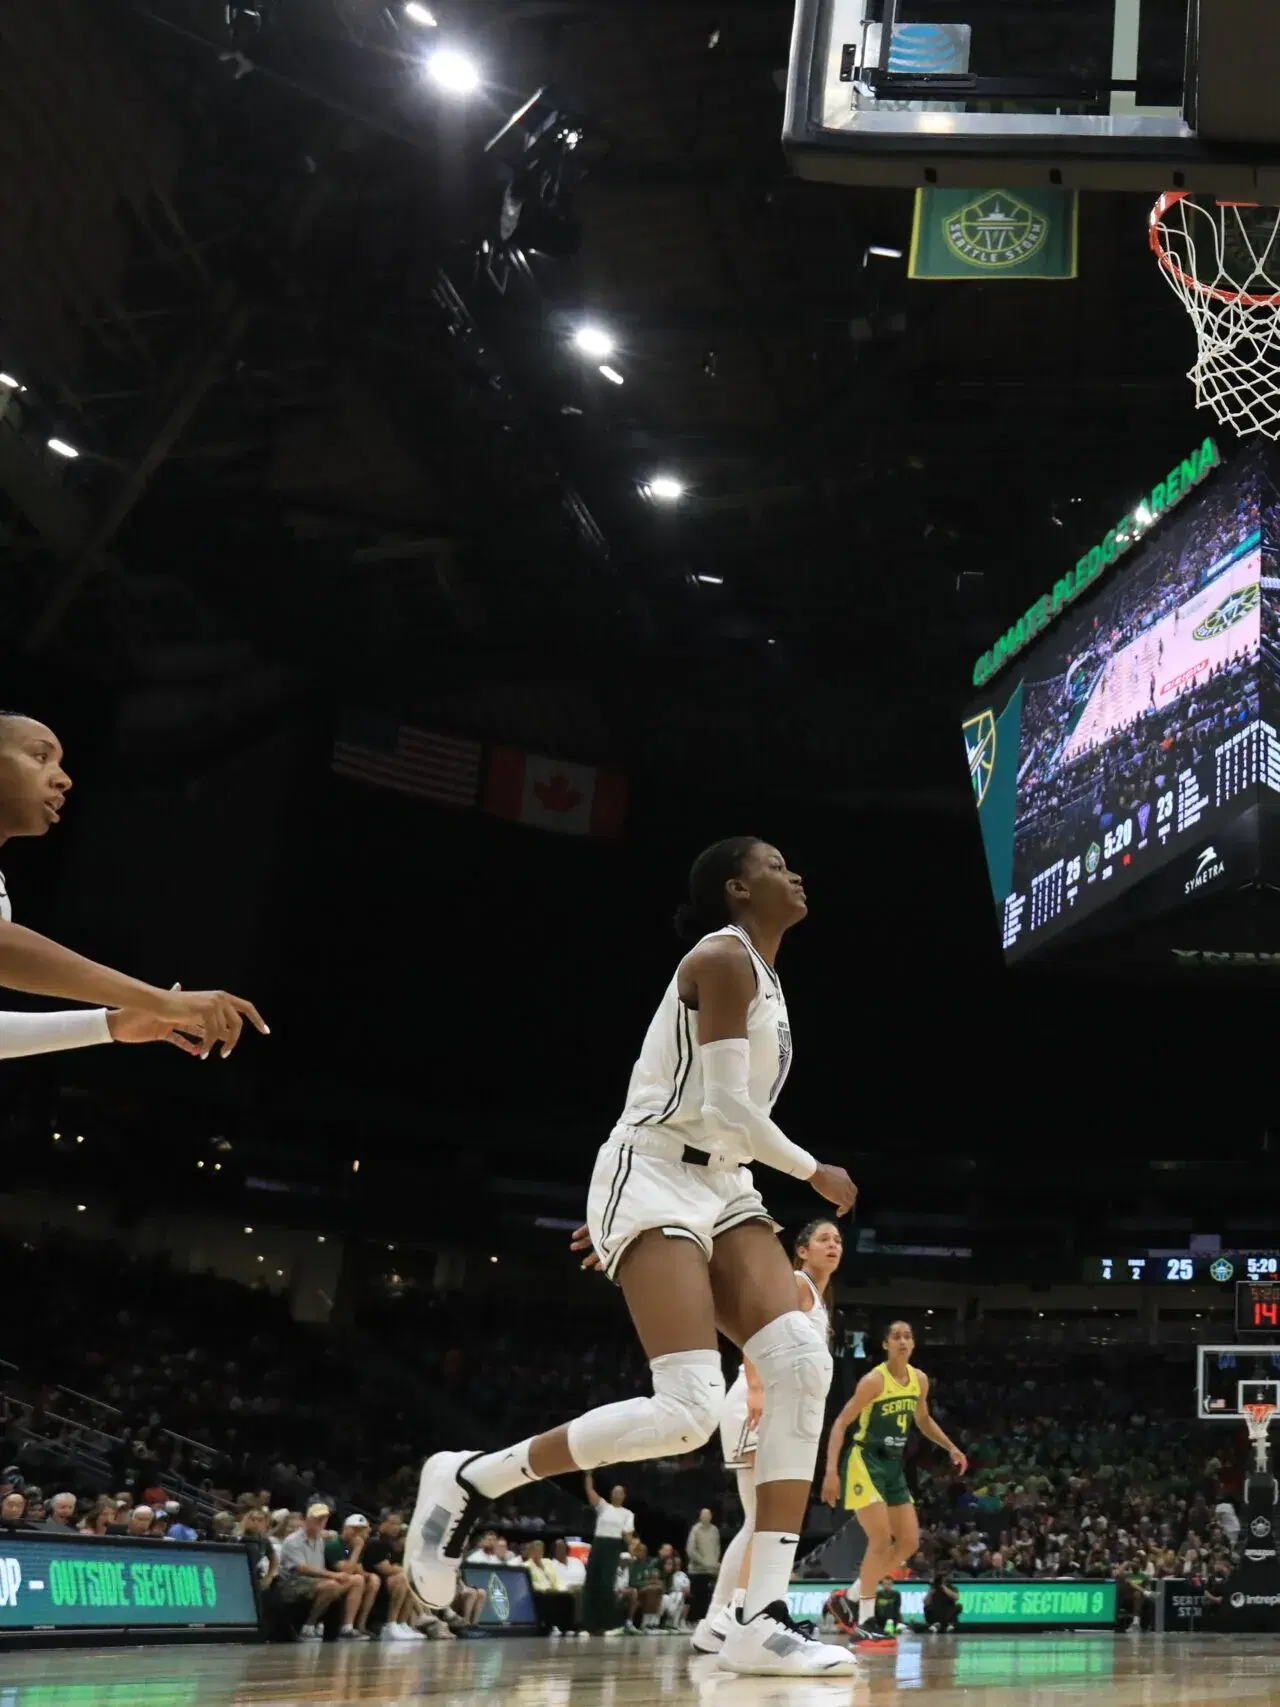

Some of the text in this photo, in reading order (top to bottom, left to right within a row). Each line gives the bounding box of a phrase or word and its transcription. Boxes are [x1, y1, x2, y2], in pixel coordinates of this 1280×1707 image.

[950, 223, 1042, 262] SEATTLE STORM
[973, 594, 1051, 686] CLIMATE
[1136, 436, 1217, 530] ARENA
[1156, 790, 1174, 823] 23
[1103, 818, 1133, 860] 5:20
[1066, 855, 1081, 886] 25
[1184, 860, 1225, 895] SYMETRA
[1131, 1267, 1141, 1280] 2
[1166, 1258, 1194, 1280] 25
[1247, 1258, 1277, 1273] 5:20
[1254, 1303, 1278, 1325] 14
[896, 1413, 908, 1434] 4
[50, 1560, 130, 1607] OUTSIDE
[130, 1563, 203, 1608] SECTION
[204, 1566, 217, 1608] 9
[1021, 1591, 1089, 1615] SECTION
[1092, 1591, 1105, 1615] 9
